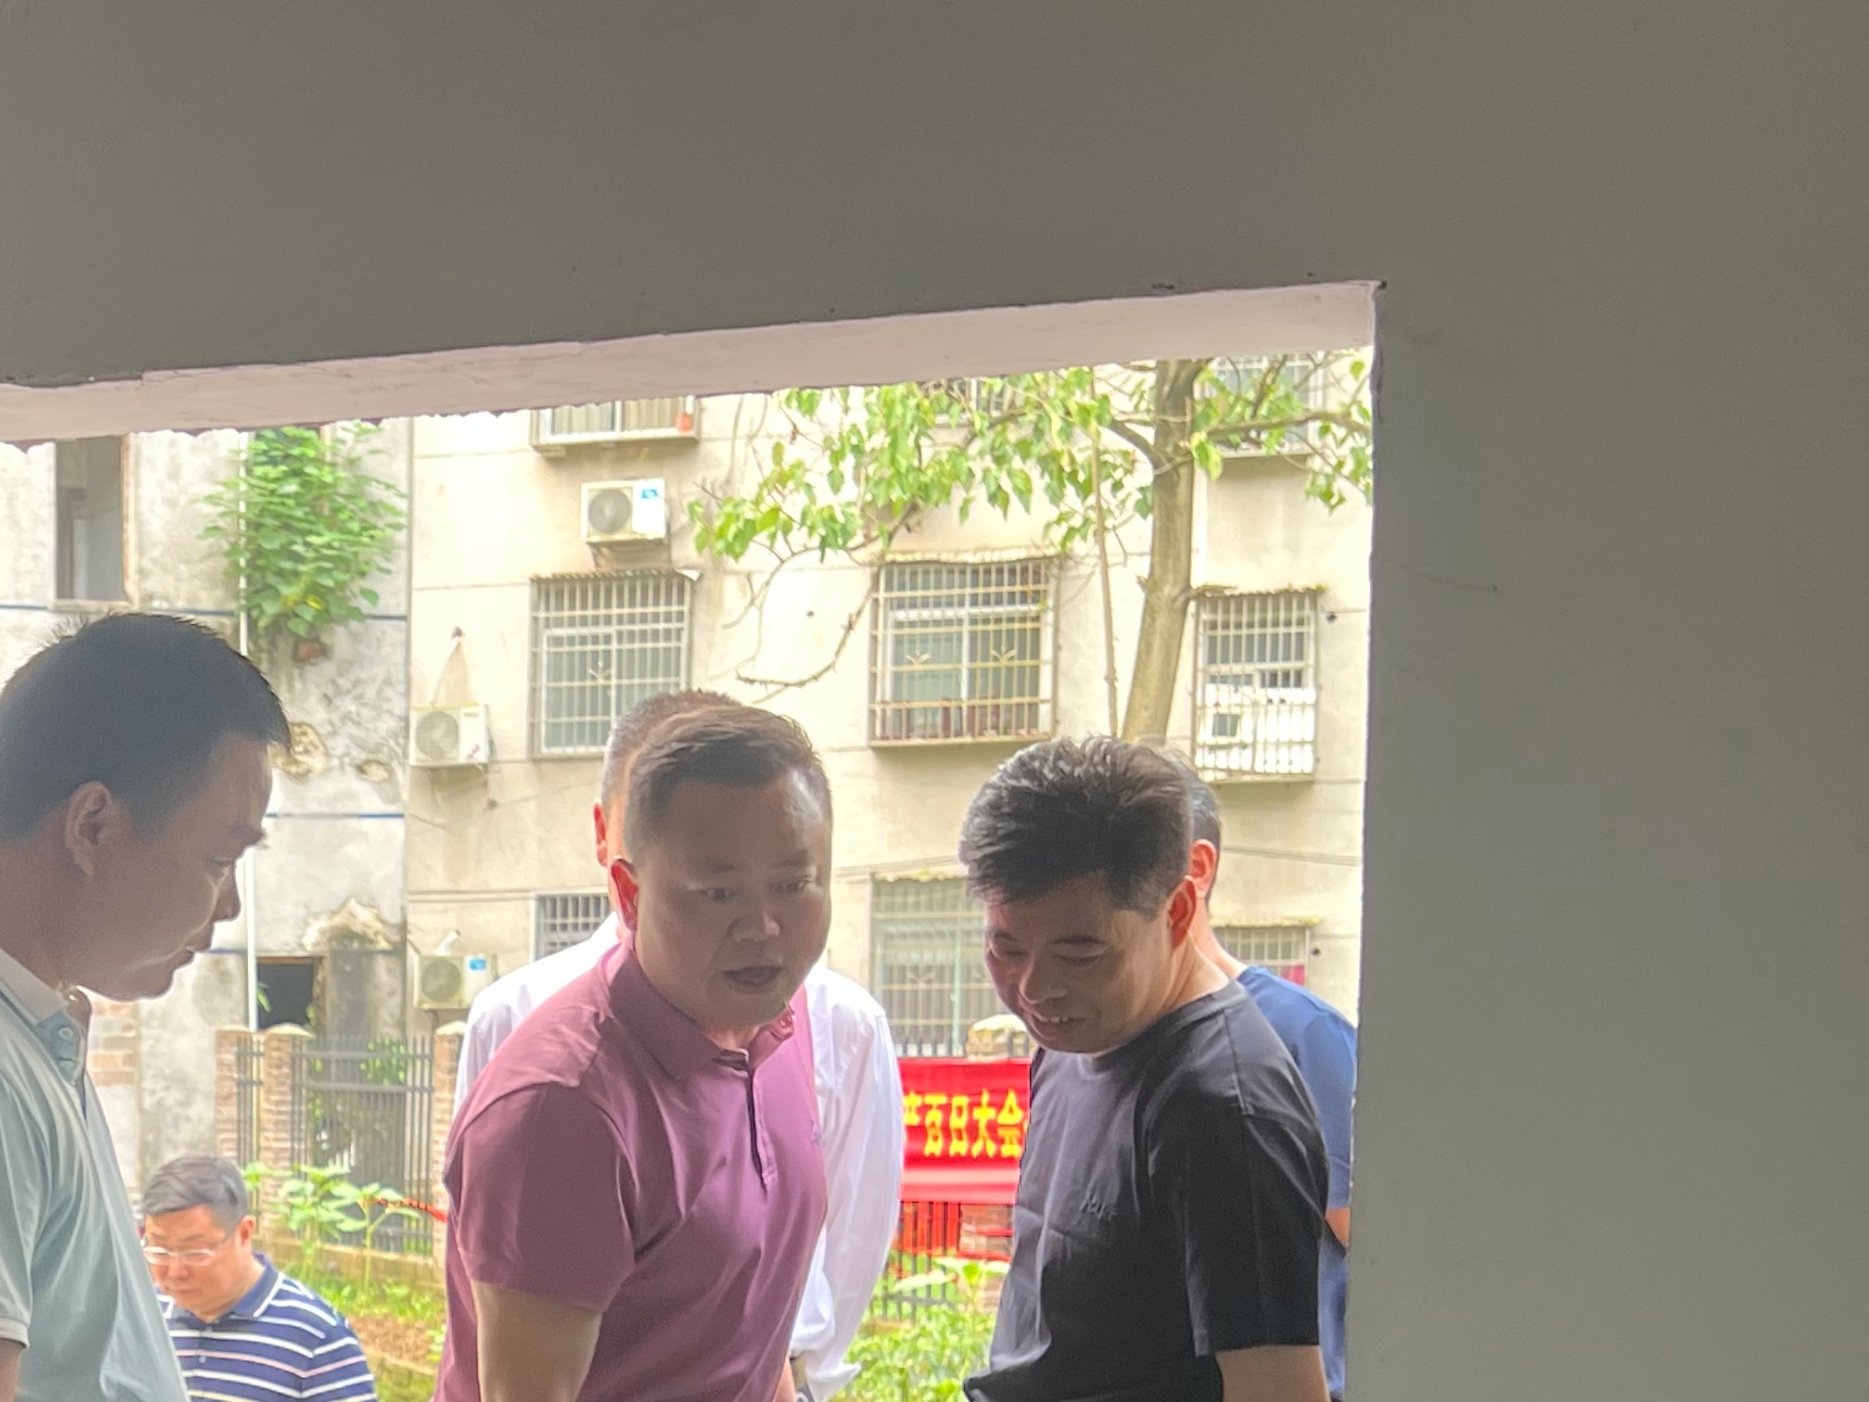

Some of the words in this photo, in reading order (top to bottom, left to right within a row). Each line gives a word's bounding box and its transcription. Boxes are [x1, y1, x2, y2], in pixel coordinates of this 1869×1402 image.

[901, 1088, 1028, 1158] 产百日大会
